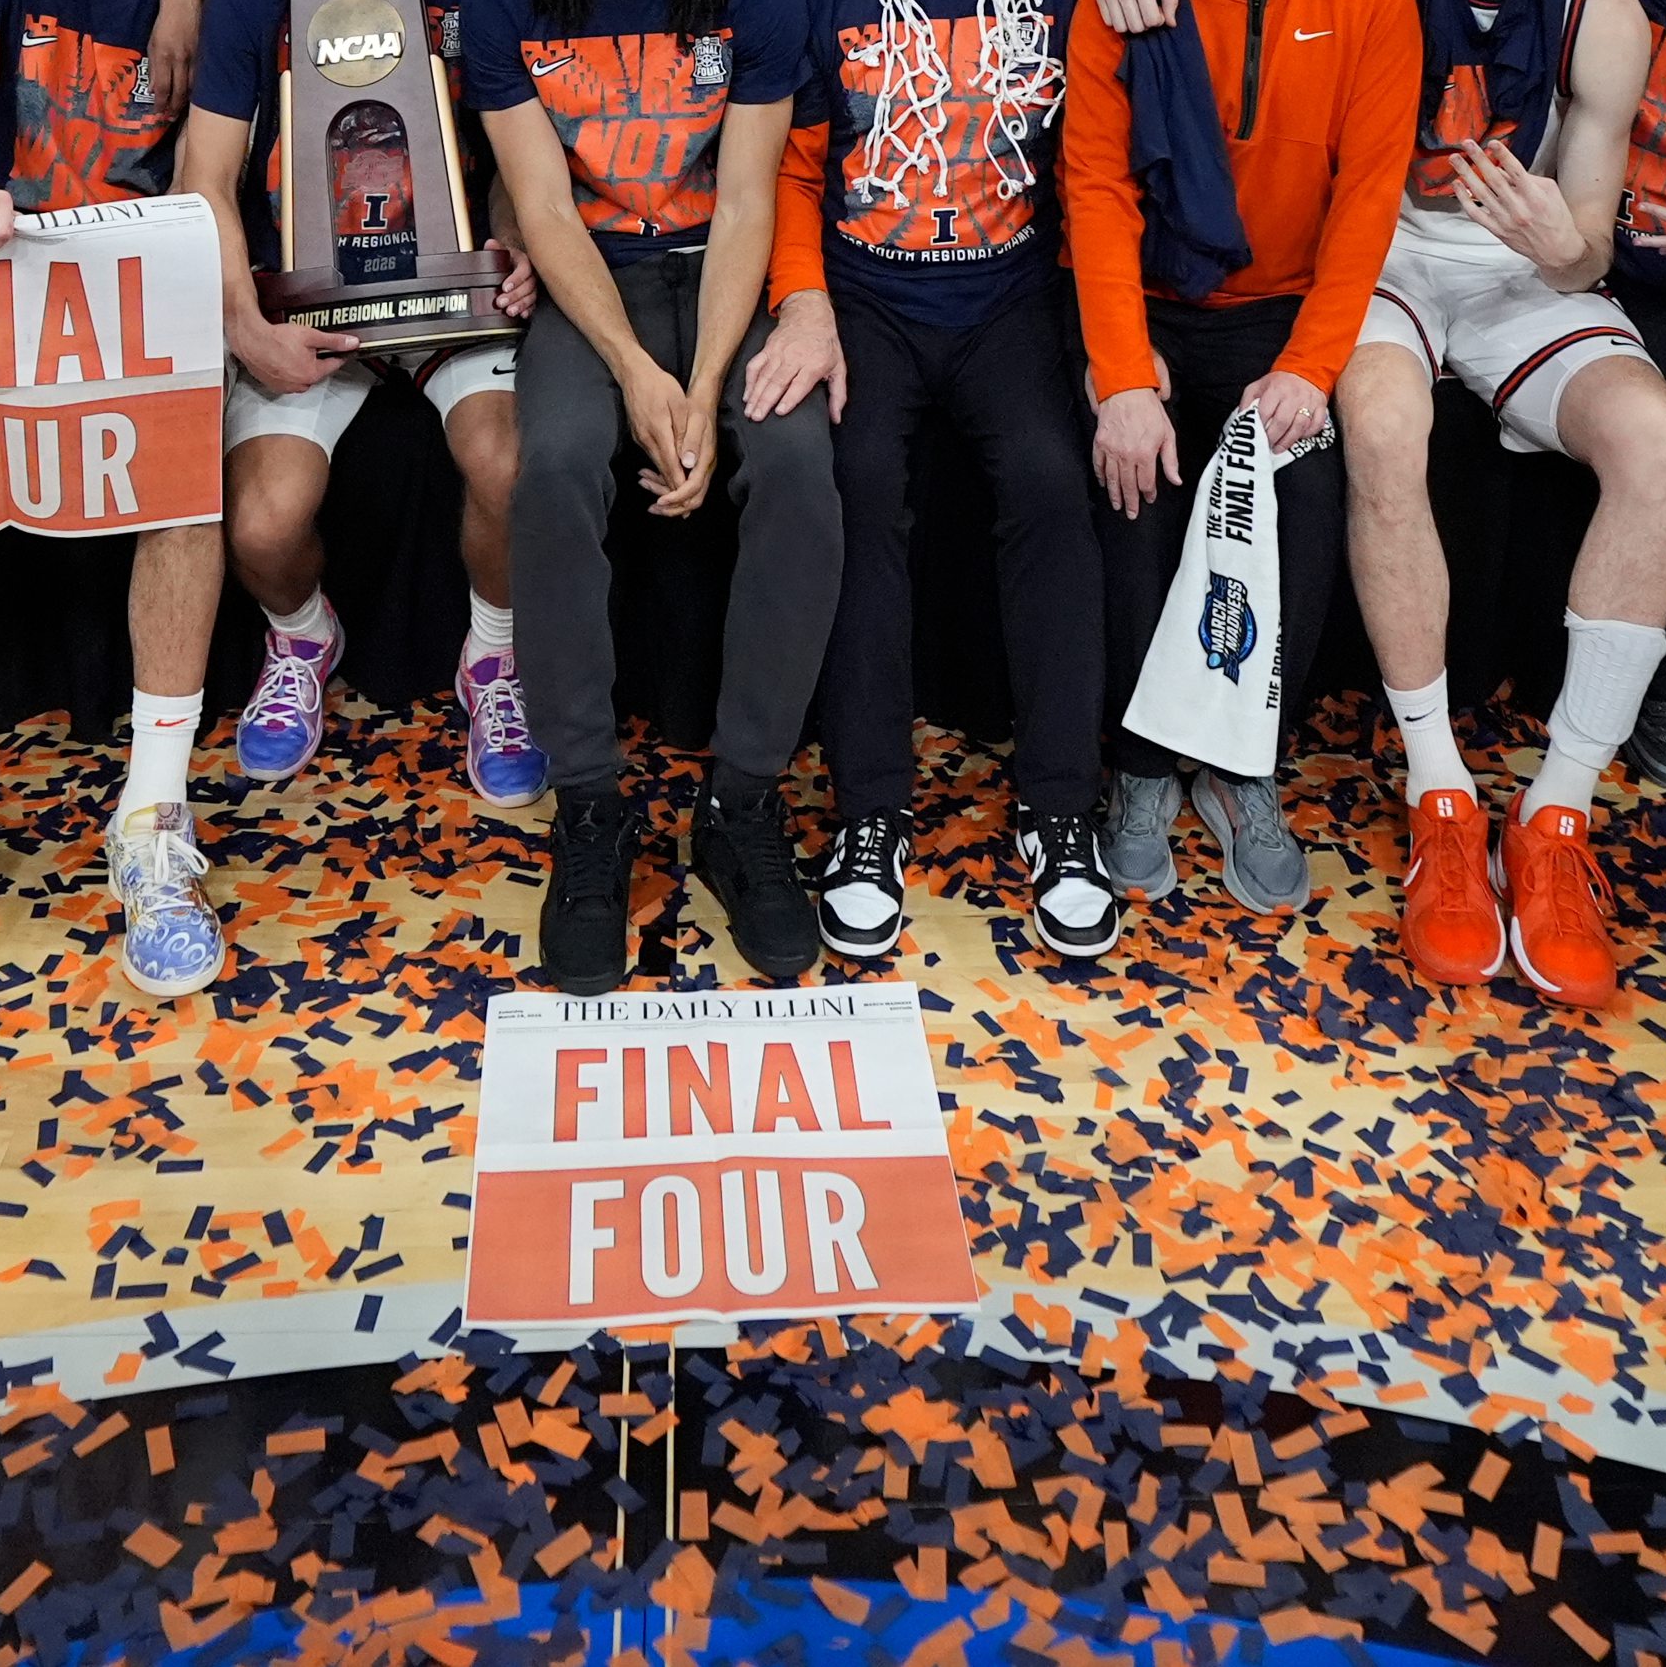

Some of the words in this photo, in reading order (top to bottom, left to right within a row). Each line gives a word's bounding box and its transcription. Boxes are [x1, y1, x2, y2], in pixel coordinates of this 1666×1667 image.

[316, 31, 402, 66] NCAA
[35, 202, 147, 231] ILLINI
[352, 231, 417, 248] REGIONAL
[867, 243, 916, 261] SOUTH
[920, 247, 994, 263] REGIONAL
[996, 224, 1036, 257] CHAMPS
[363, 256, 397, 273] 2026
[289, 307, 331, 328] SOUTH
[333, 301, 395, 325] REGIONAL
[397, 294, 469, 318] CHAMPION
[1226, 408, 1256, 471] FOUR
[1209, 464, 1224, 509] ROAD
[1206, 510, 1223, 541] THE
[1225, 480, 1255, 546] FINAL
[1211, 598, 1226, 653] MARCH
[1227, 578, 1248, 652] MADNESS
[1266, 682, 1282, 710] THE
[555, 1001, 630, 1023] THE
[641, 998, 740, 1021] DAILY
[751, 994, 858, 1019] ILLINI
[552, 1039, 893, 1144] FINAL
[567, 1169, 882, 1306] FOUR
